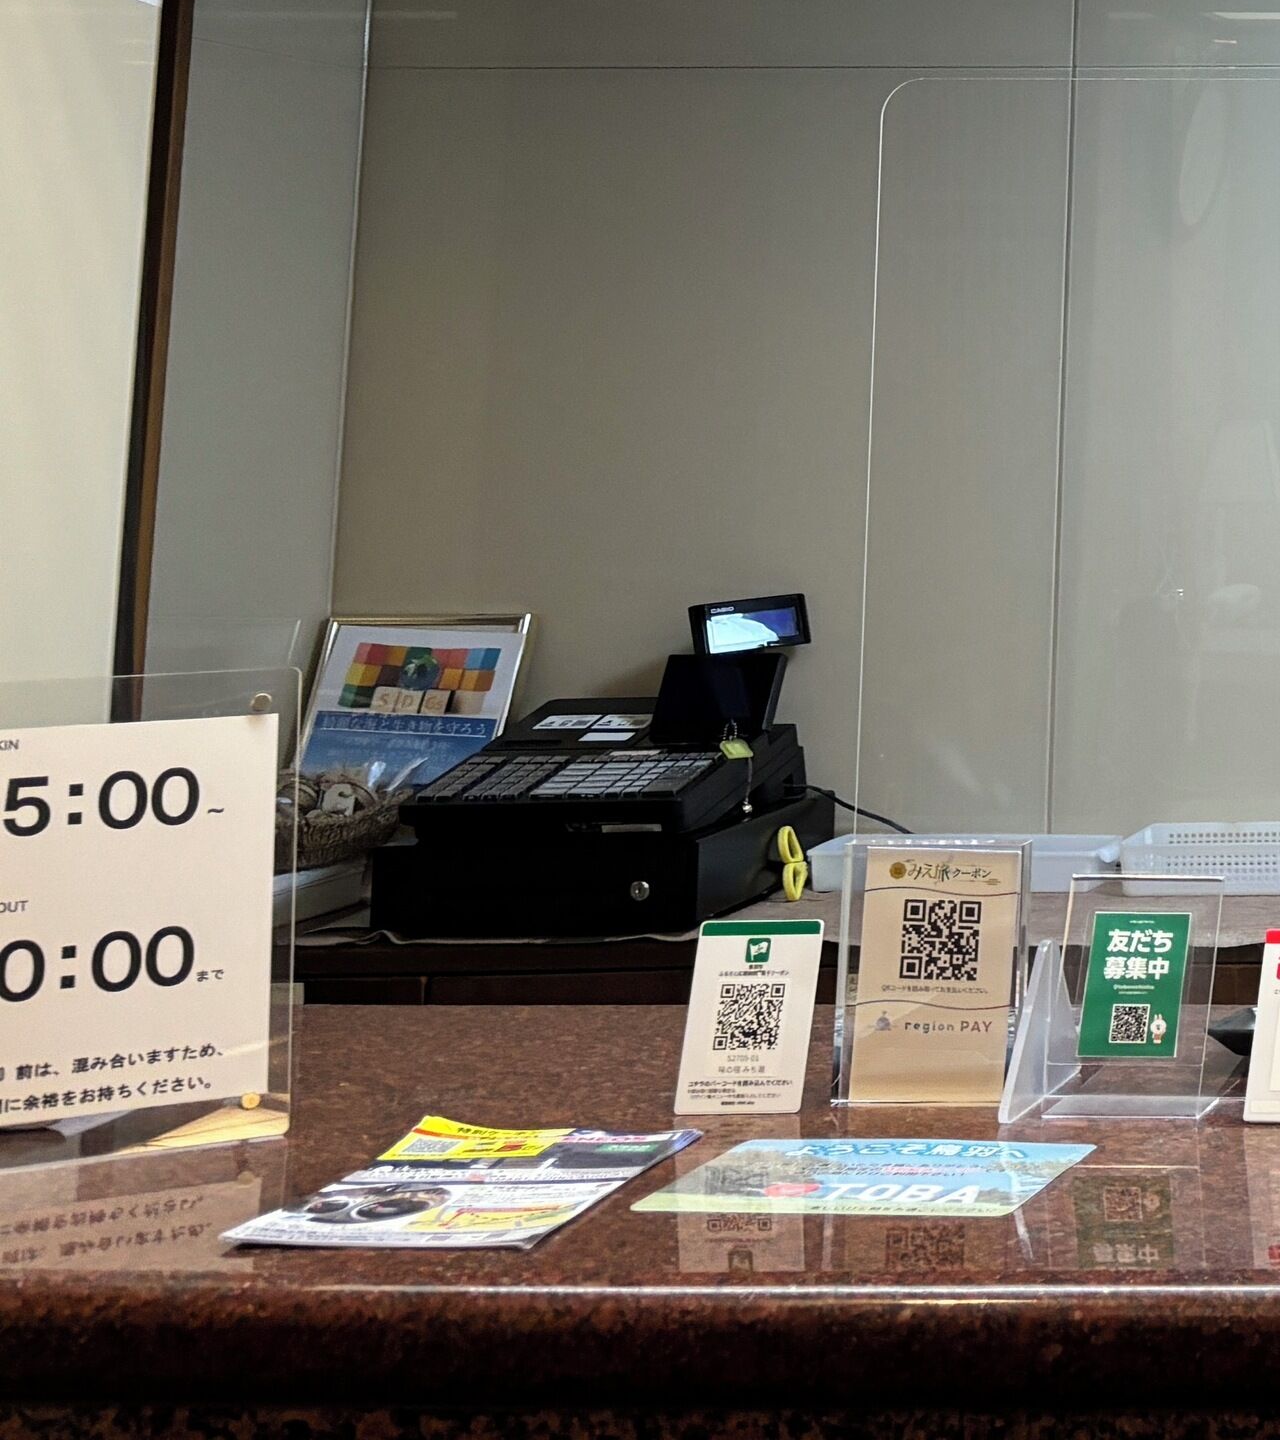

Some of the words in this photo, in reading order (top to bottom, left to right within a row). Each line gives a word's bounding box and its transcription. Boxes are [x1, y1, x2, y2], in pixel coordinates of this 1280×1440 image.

[1106, 928, 1174, 953] 友だち
[1103, 956, 1170, 980] 募集中
[904, 1020, 955, 1035] region
[959, 1020, 993, 1033] PAY
[0, 1075, 213, 1114] に余裕をお持ちください。
[822, 1183, 980, 1204] TOBA
